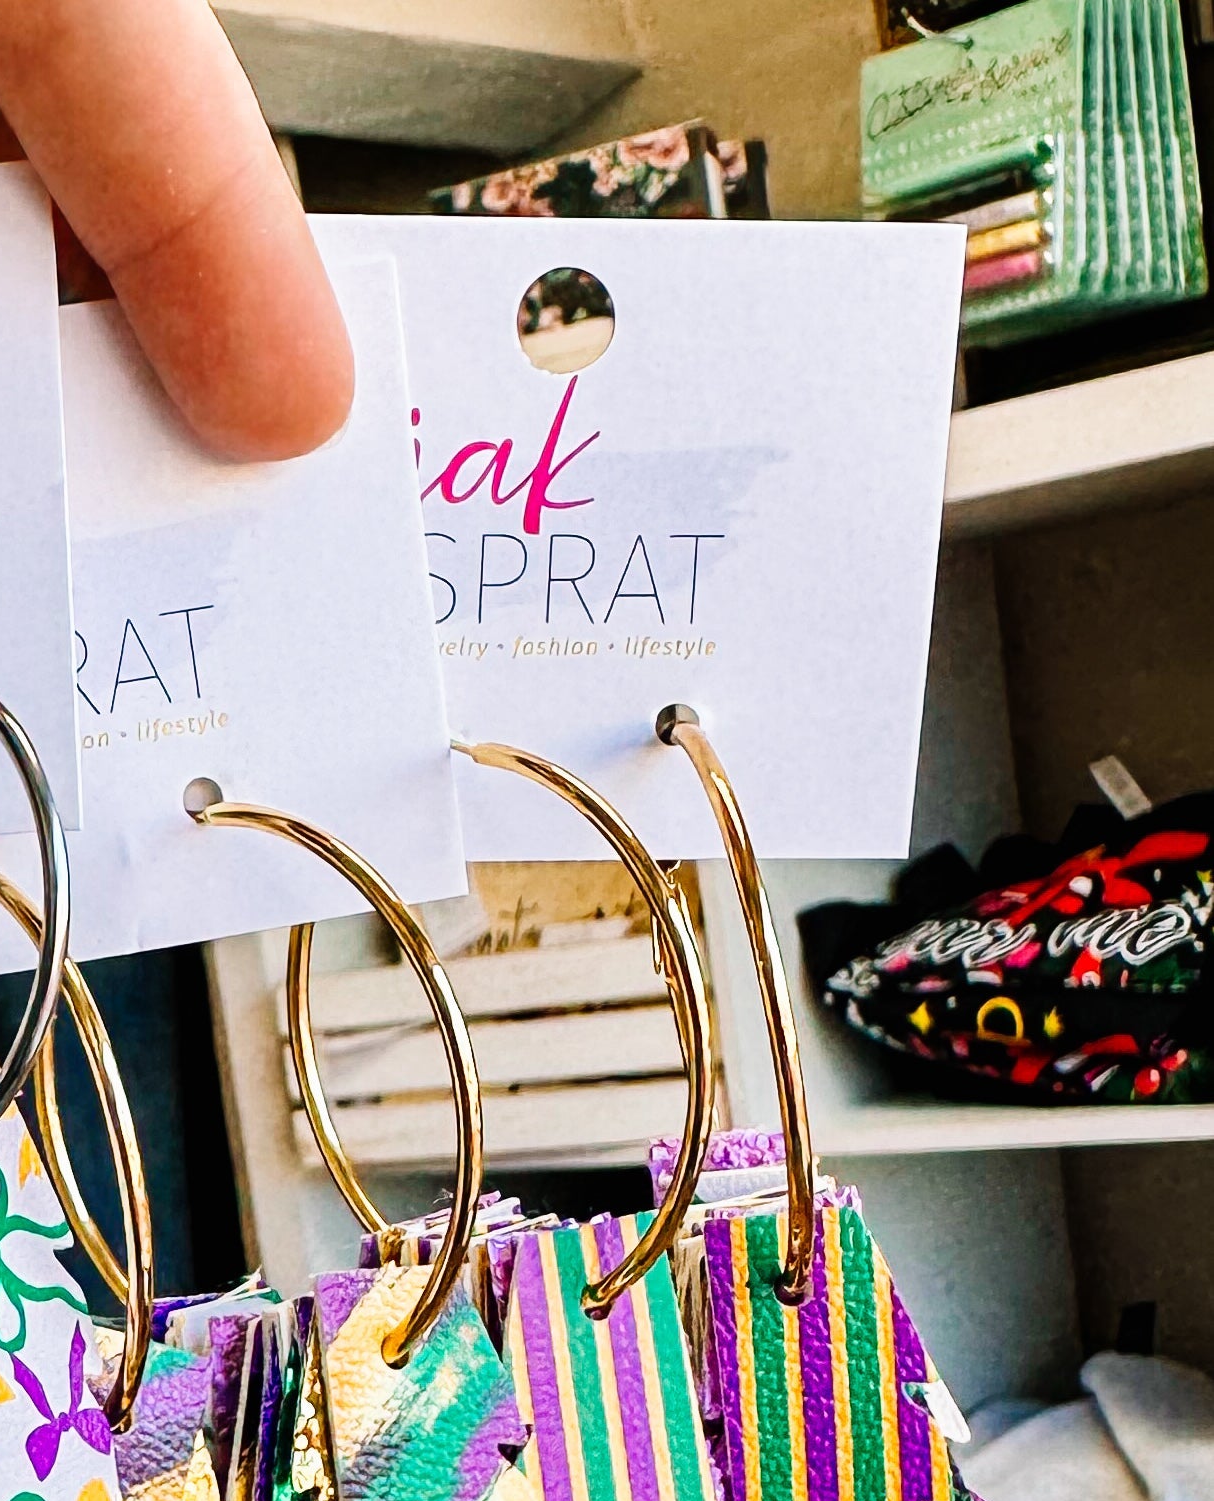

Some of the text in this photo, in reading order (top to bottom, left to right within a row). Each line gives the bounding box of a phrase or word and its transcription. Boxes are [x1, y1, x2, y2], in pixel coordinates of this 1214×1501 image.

[512, 636, 598, 659] fashion
[625, 637, 717, 660] lifestyle
[137, 709, 229, 742] lifestyle
